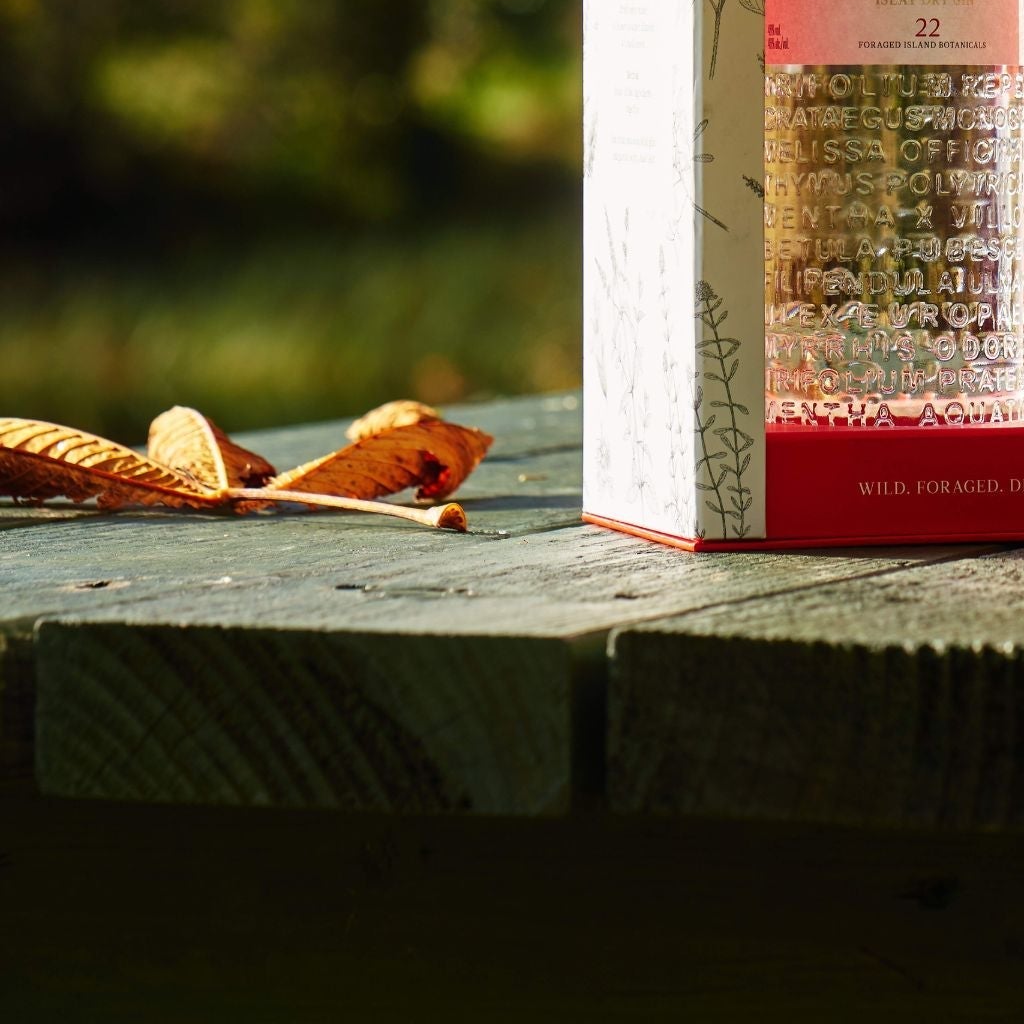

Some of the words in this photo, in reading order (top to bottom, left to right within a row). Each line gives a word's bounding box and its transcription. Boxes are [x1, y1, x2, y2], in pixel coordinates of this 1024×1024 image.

[915, 18, 940, 37] 22
[858, 41, 901, 49] FORAGED
[903, 41, 937, 49] ISLAND
[938, 41, 987, 49] BOTANICALS
[858, 481, 910, 496] WILD.
[916, 479, 1003, 495] FORAGED.
